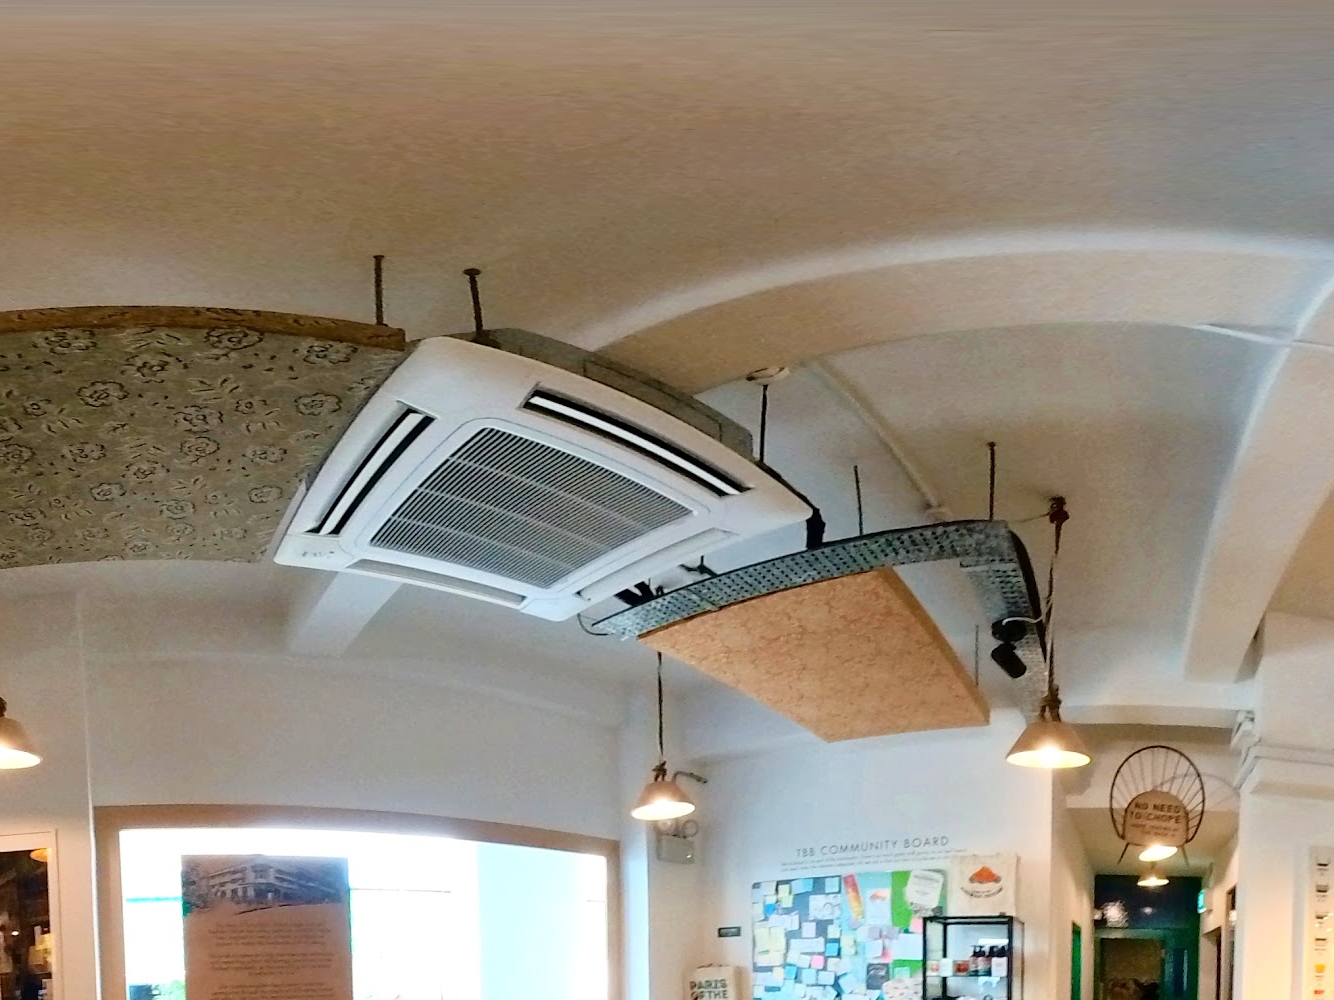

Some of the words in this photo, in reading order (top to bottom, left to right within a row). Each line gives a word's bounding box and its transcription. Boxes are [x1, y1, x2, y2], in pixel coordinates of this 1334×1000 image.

[1153, 803, 1181, 814] NEED
[795, 847, 816, 858] TBB
[820, 840, 898, 856] COMMUNITY
[903, 835, 949, 850] BOARD
[689, 979, 727, 991] PARIS
